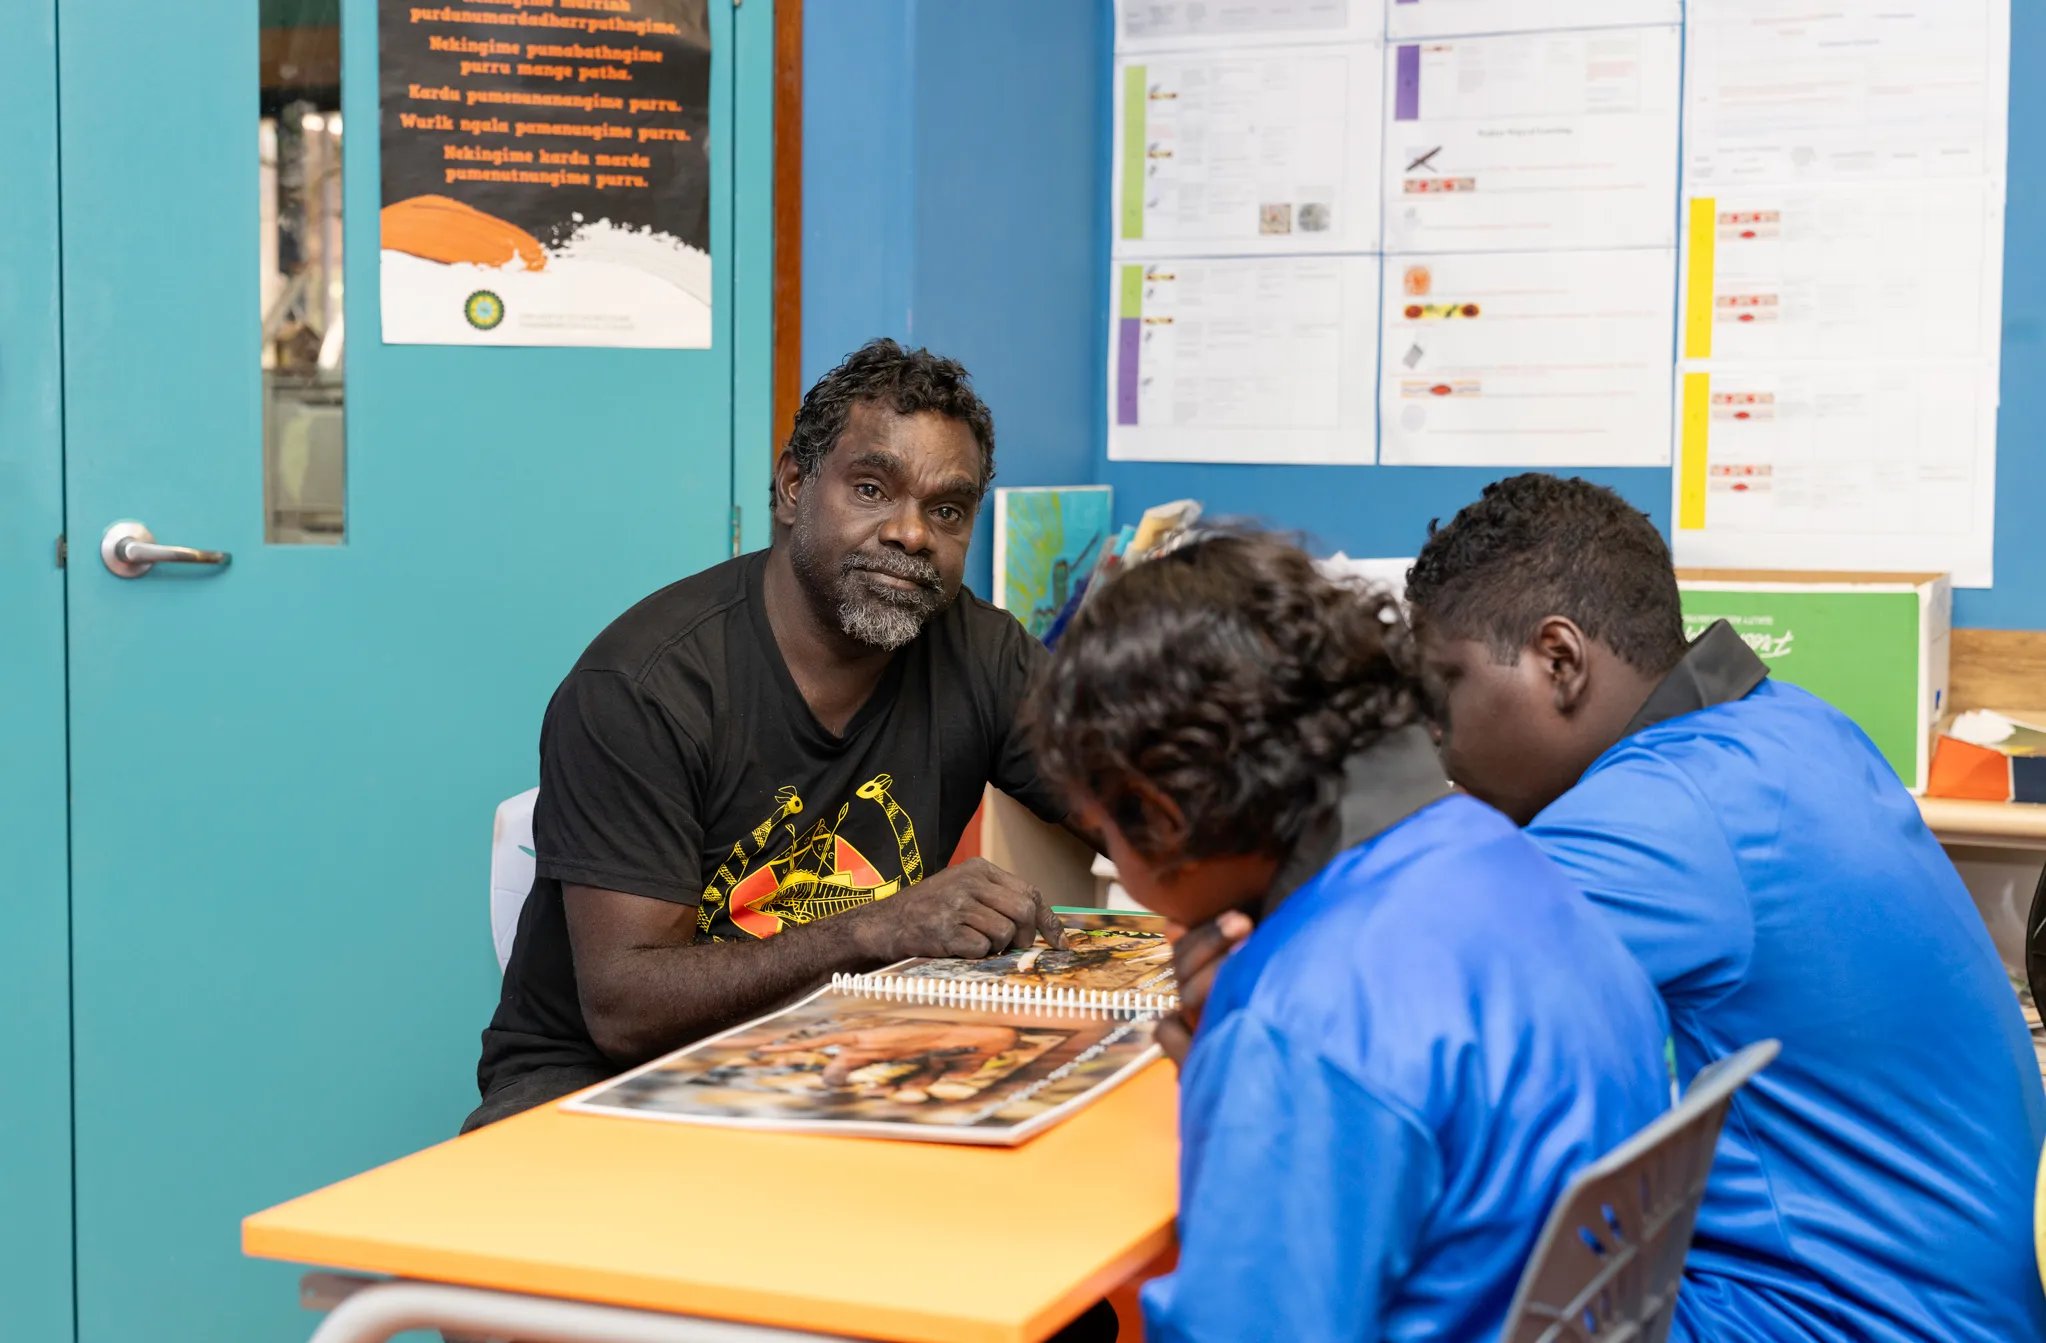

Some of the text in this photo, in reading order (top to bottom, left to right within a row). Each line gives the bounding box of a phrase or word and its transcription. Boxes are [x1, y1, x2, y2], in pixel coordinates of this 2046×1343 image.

[461, 61, 510, 75] purru
[578, 66, 632, 82] patha.
[410, 84, 460, 100] Kardu
[629, 99, 681, 113] purru.
[638, 128, 690, 142] purru.
[596, 175, 648, 189] purru.
